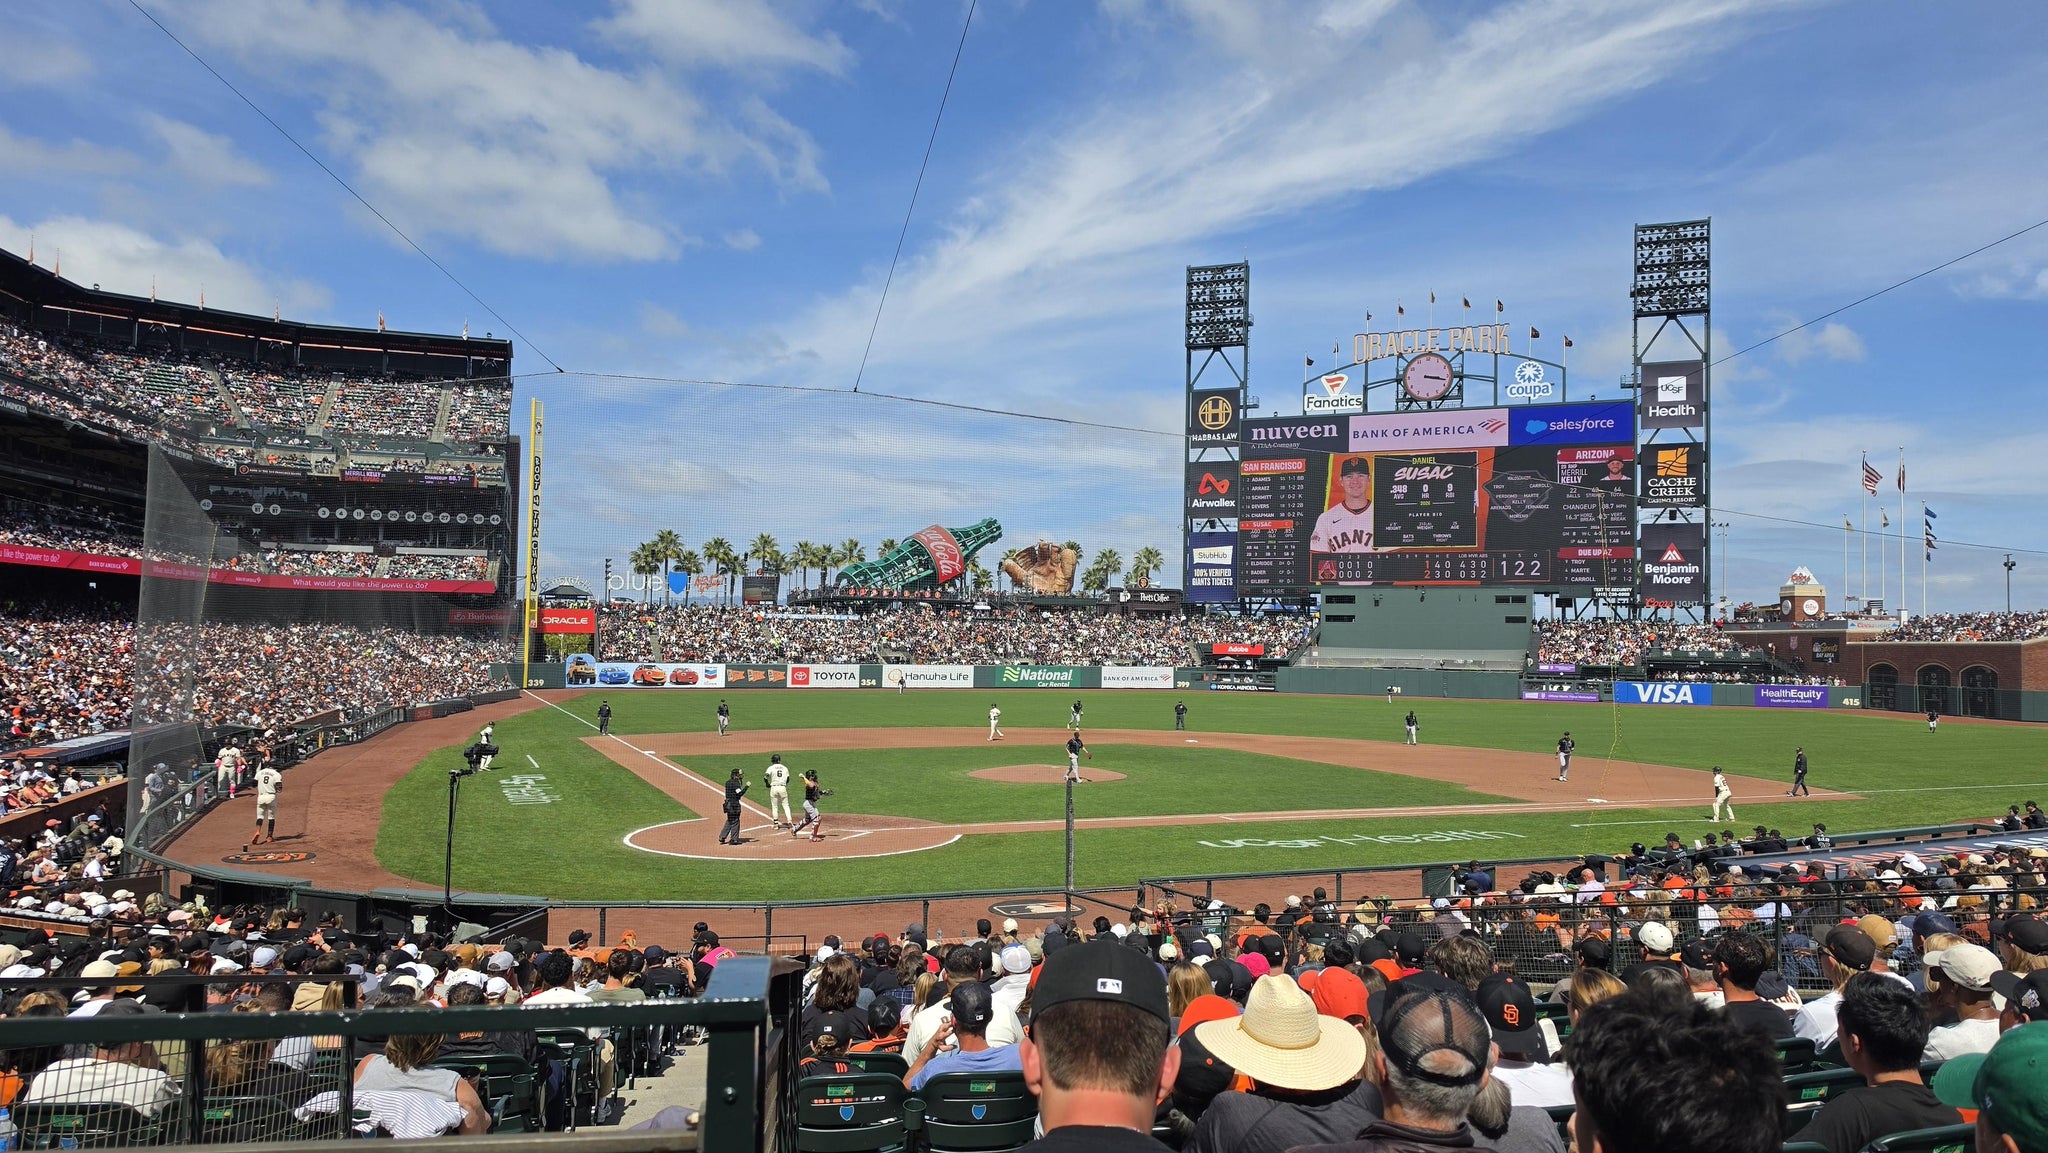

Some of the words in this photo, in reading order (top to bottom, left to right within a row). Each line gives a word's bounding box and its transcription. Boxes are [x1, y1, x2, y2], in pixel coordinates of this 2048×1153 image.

[1354, 329, 1440, 364] ORACLE
[1449, 323, 1510, 355] PARK
[1510, 384, 1550, 398] coupa
[1660, 384, 1684, 394] UCSF
[1306, 396, 1362, 408] Fanatics
[1648, 404, 1696, 417] Health
[1550, 418, 1614, 432] salesforce
[1251, 422, 1338, 440] nuveen
[1353, 429, 1388, 439] BANK
[1392, 428, 1408, 438] OF
[1412, 426, 1474, 436] AMERICA
[1192, 433, 1221, 442] HABBAS
[1576, 450, 1615, 460] ARIZONA
[1244, 463, 1259, 472] SAN
[1260, 462, 1302, 470] FRANCISCO
[1394, 466, 1454, 480] SUSAC
[1447, 483, 1453, 491] 9
[1648, 478, 1696, 486] CACHE
[1390, 485, 1408, 493] .348
[1423, 484, 1428, 492] 0
[1649, 487, 1695, 496] CREEK
[1192, 499, 1235, 508] Airwallex
[1209, 568, 1231, 576] VERIFIED
[1501, 561, 1506, 575] 1
[1515, 561, 1524, 575] 2
[1531, 561, 1540, 575] 2
[1645, 563, 1699, 576] Benjamin
[1424, 570, 1430, 578] 2
[1192, 578, 1211, 586] GIANTS
[1211, 577, 1233, 586] TICKETS
[1653, 575, 1691, 584] Moore
[1154, 593, 1169, 602] Coffee
[1645, 597, 1674, 608] Coors
[814, 672, 856, 681] TOYOTA
[905, 672, 947, 681] Hanwha
[950, 672, 968, 681] Life
[1021, 668, 1072, 681] National
[1632, 684, 1693, 703] VISA
[1761, 689, 1822, 700] HealthEquity
[263, 776, 269, 784] 8
[1197, 838, 1325, 848] UCSF
[1320, 830, 1526, 846] Health
